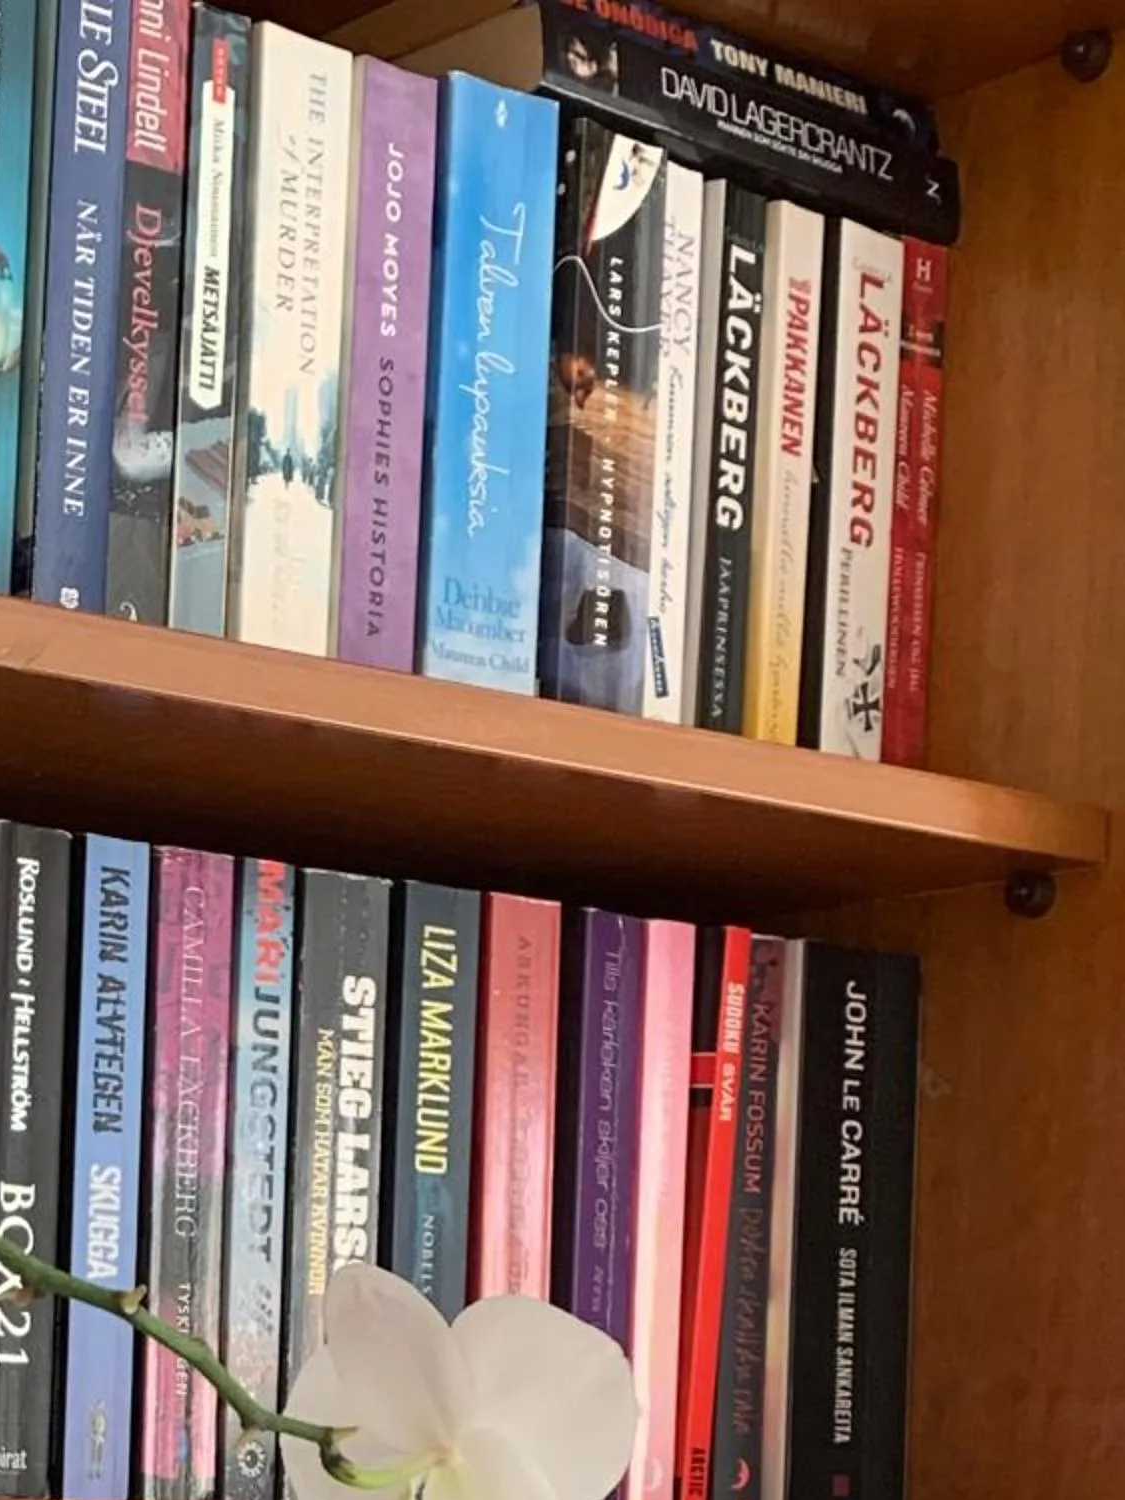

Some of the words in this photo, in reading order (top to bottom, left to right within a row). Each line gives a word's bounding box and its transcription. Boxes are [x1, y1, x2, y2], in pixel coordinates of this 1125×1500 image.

[74, 49, 119, 155] STEEL
[134, 49, 171, 154] Lindell
[306, 73, 328, 123] THE
[661, 66, 729, 118] DAVID
[730, 92, 894, 182] LAGERCRANTZ
[711, 38, 768, 79] TONY
[776, 63, 868, 115] MANIERI
[75, 199, 103, 266] NÄR
[385, 142, 405, 224] JOJO
[275, 168, 299, 313] MURDER
[298, 136, 326, 376] INTERPRETATION
[380, 232, 404, 338] MOYES
[607, 256, 624, 317] LARS
[70, 277, 95, 377] TIDEN
[122, 202, 163, 424] Djevelkysset
[672, 232, 697, 357] NANCY
[67, 385, 90, 428] ER
[374, 356, 395, 486] SOPHIES
[715, 243, 762, 531] LÄCKBERG
[780, 290, 812, 457] PAKKANEN
[849, 272, 891, 548] LÄCKBERG
[63, 437, 89, 518] INNE
[365, 497, 390, 638] HISTORIA
[591, 457, 617, 648] HYPNOTISÖREN
[15, 857, 41, 973] ROSLUND
[98, 865, 132, 964] KARIN
[180, 884, 206, 1038] CAMILLA
[255, 859, 285, 986] MARI
[420, 924, 459, 990] LIZA
[9, 991, 36, 1133] HELLSTRÖM
[91, 972, 128, 1136] ALVTEGEN
[337, 975, 377, 1119] STIEG
[722, 981, 745, 1054] SUDOKU
[748, 1002, 774, 1083] KARIN
[844, 980, 867, 1072] JOHN
[314, 1082, 333, 1125] SOM
[413, 999, 454, 1174] MARKLUND
[842, 1078, 861, 1112] LE
[172, 1053, 205, 1238] LÄCKBERG
[310, 1131, 330, 1199] HATAR
[593, 1118, 616, 1190] skiljer
[743, 1089, 766, 1194] FOSSUM
[837, 1119, 865, 1226] CARRÉ
[85, 1163, 122, 1281] SKUGGA
[308, 1204, 328, 1296] KVINNOR
[593, 1198, 609, 1251] oss
[838, 1247, 858, 1287] SOTA
[836, 1292, 856, 1343] ILMAN
[833, 1346, 854, 1443] SANKAREITA
[689, 1447, 707, 1498] ARCTIC
